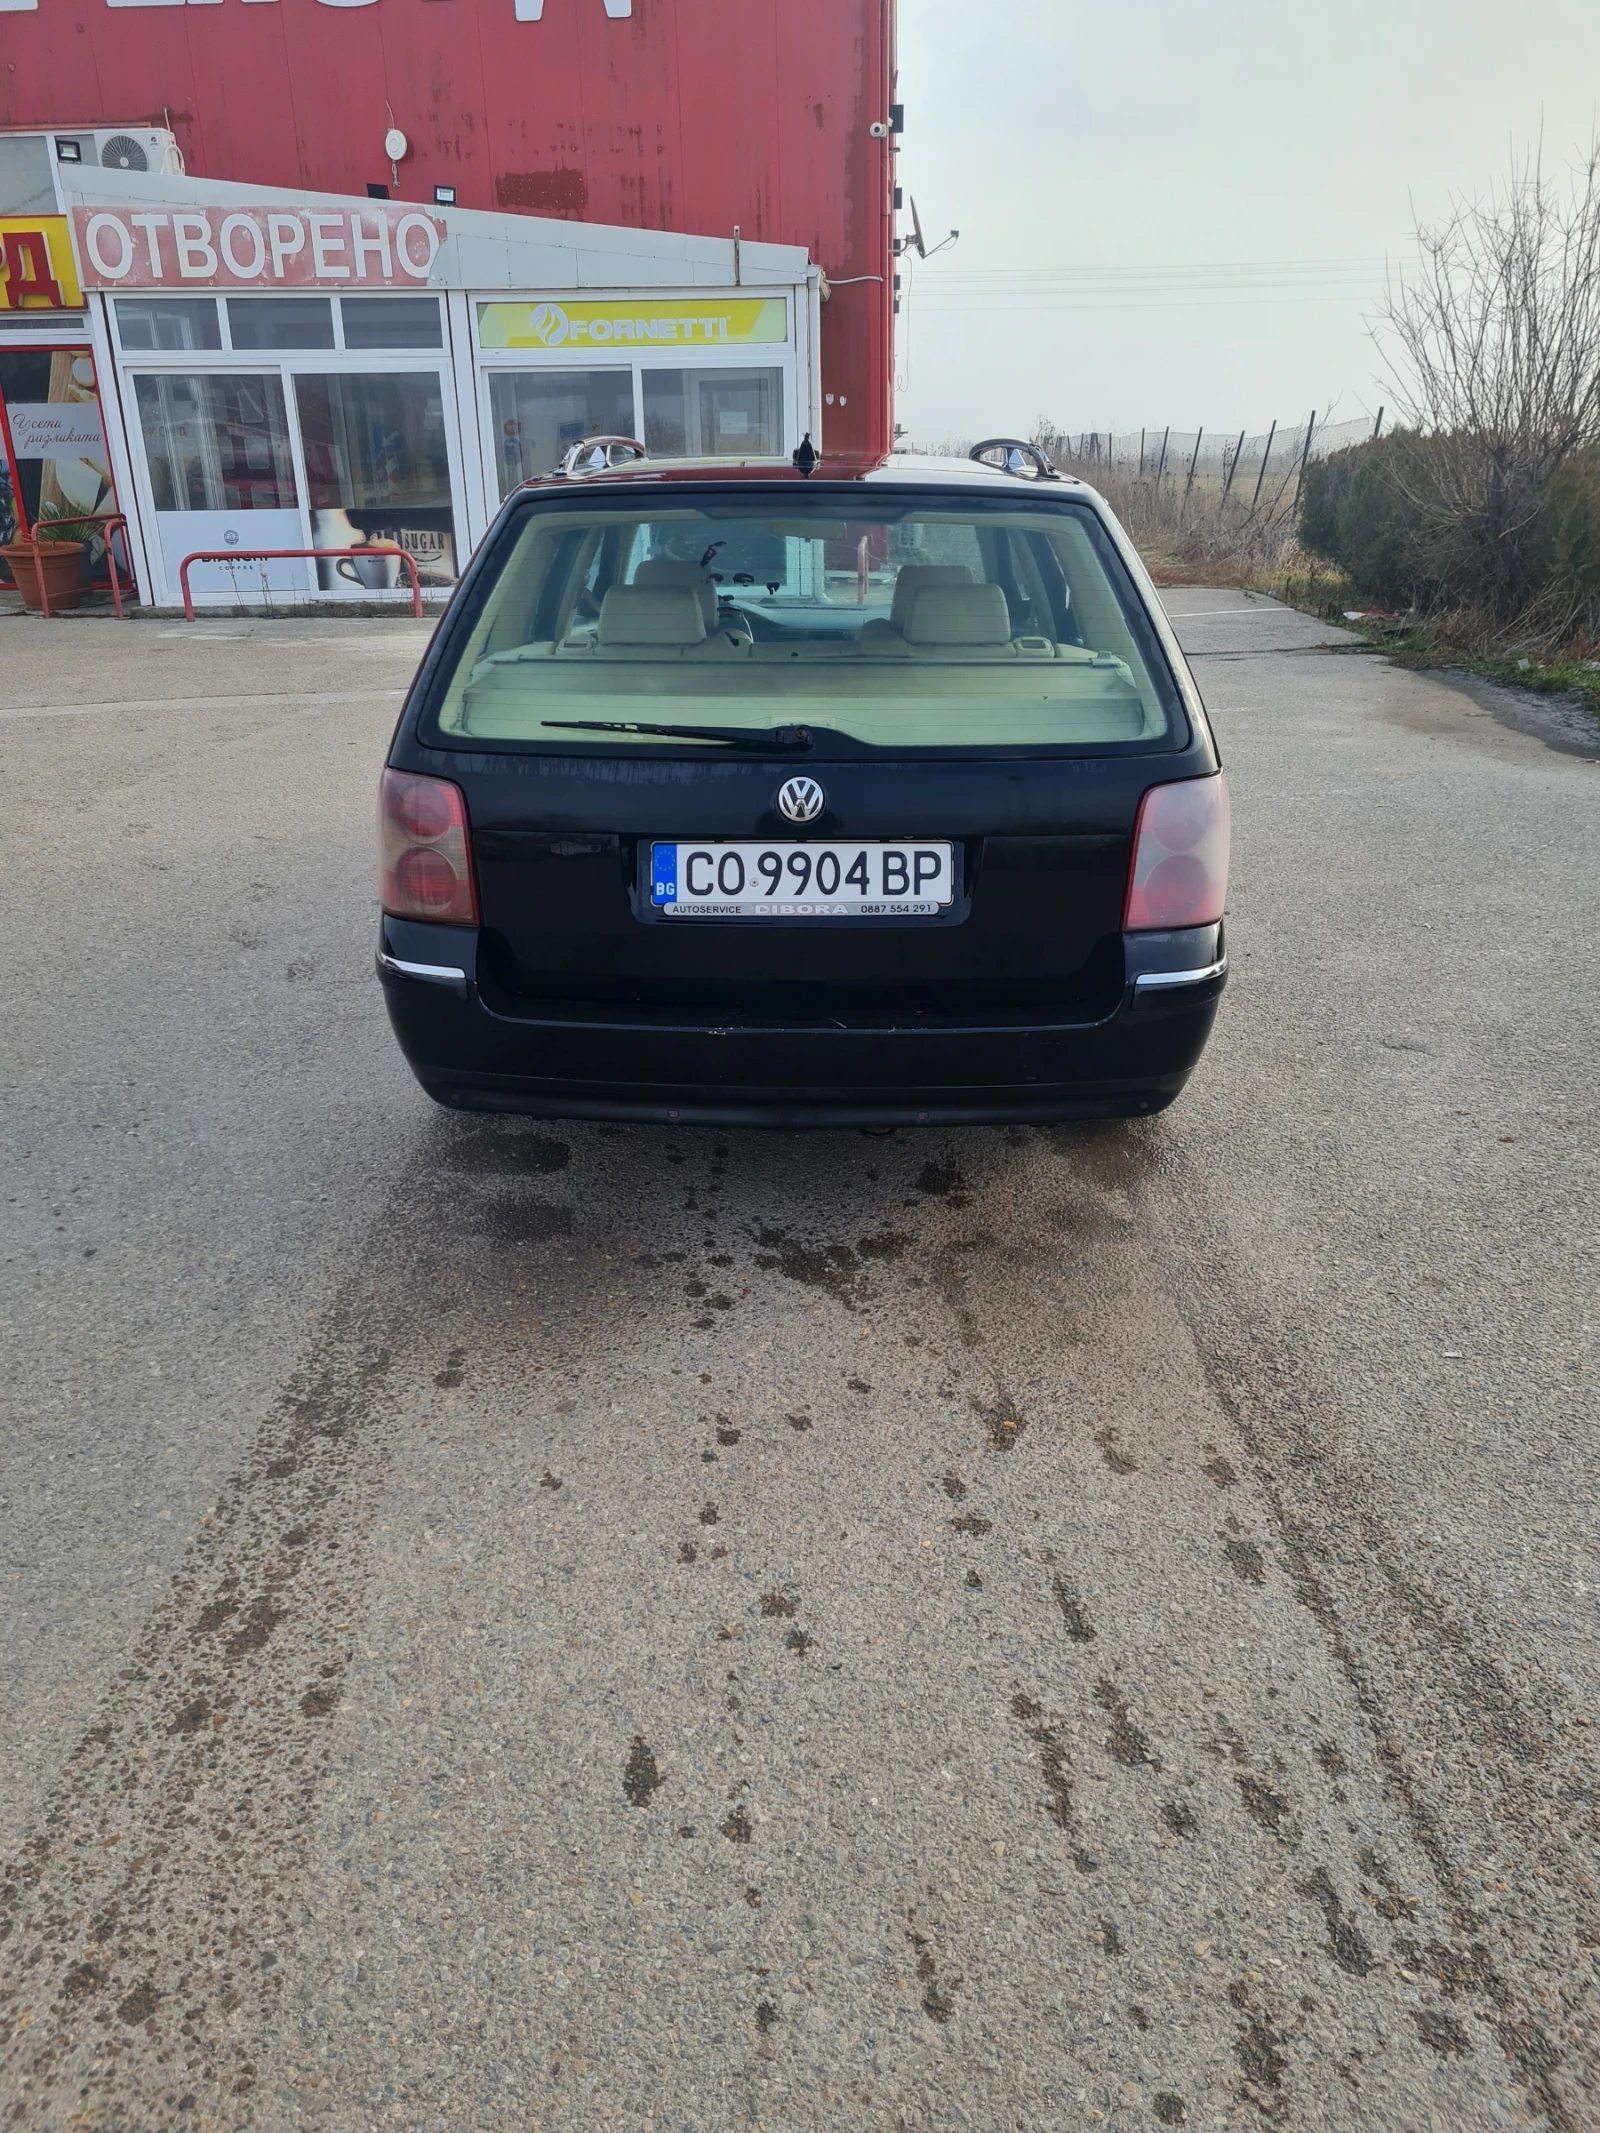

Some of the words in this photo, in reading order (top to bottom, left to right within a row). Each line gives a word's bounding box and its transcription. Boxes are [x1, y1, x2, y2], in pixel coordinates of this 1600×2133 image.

[86, 213, 440, 279] ОТВОРЕНО
[0, 231, 66, 308] Д
[569, 317, 728, 341] FORNETTI
[12, 413, 63, 435] Усети
[23, 427, 102, 449] разликата
[404, 533, 445, 549] SUGAR
[757, 851, 870, 896] 9904
[882, 851, 942, 896] BP
[656, 882, 675, 896] BG
[672, 905, 742, 914] AUTOSERVICE
[754, 904, 849, 915] DIBORA
[861, 905, 887, 914] 0887
[889, 905, 910, 913] 554
[912, 904, 931, 913] 291
